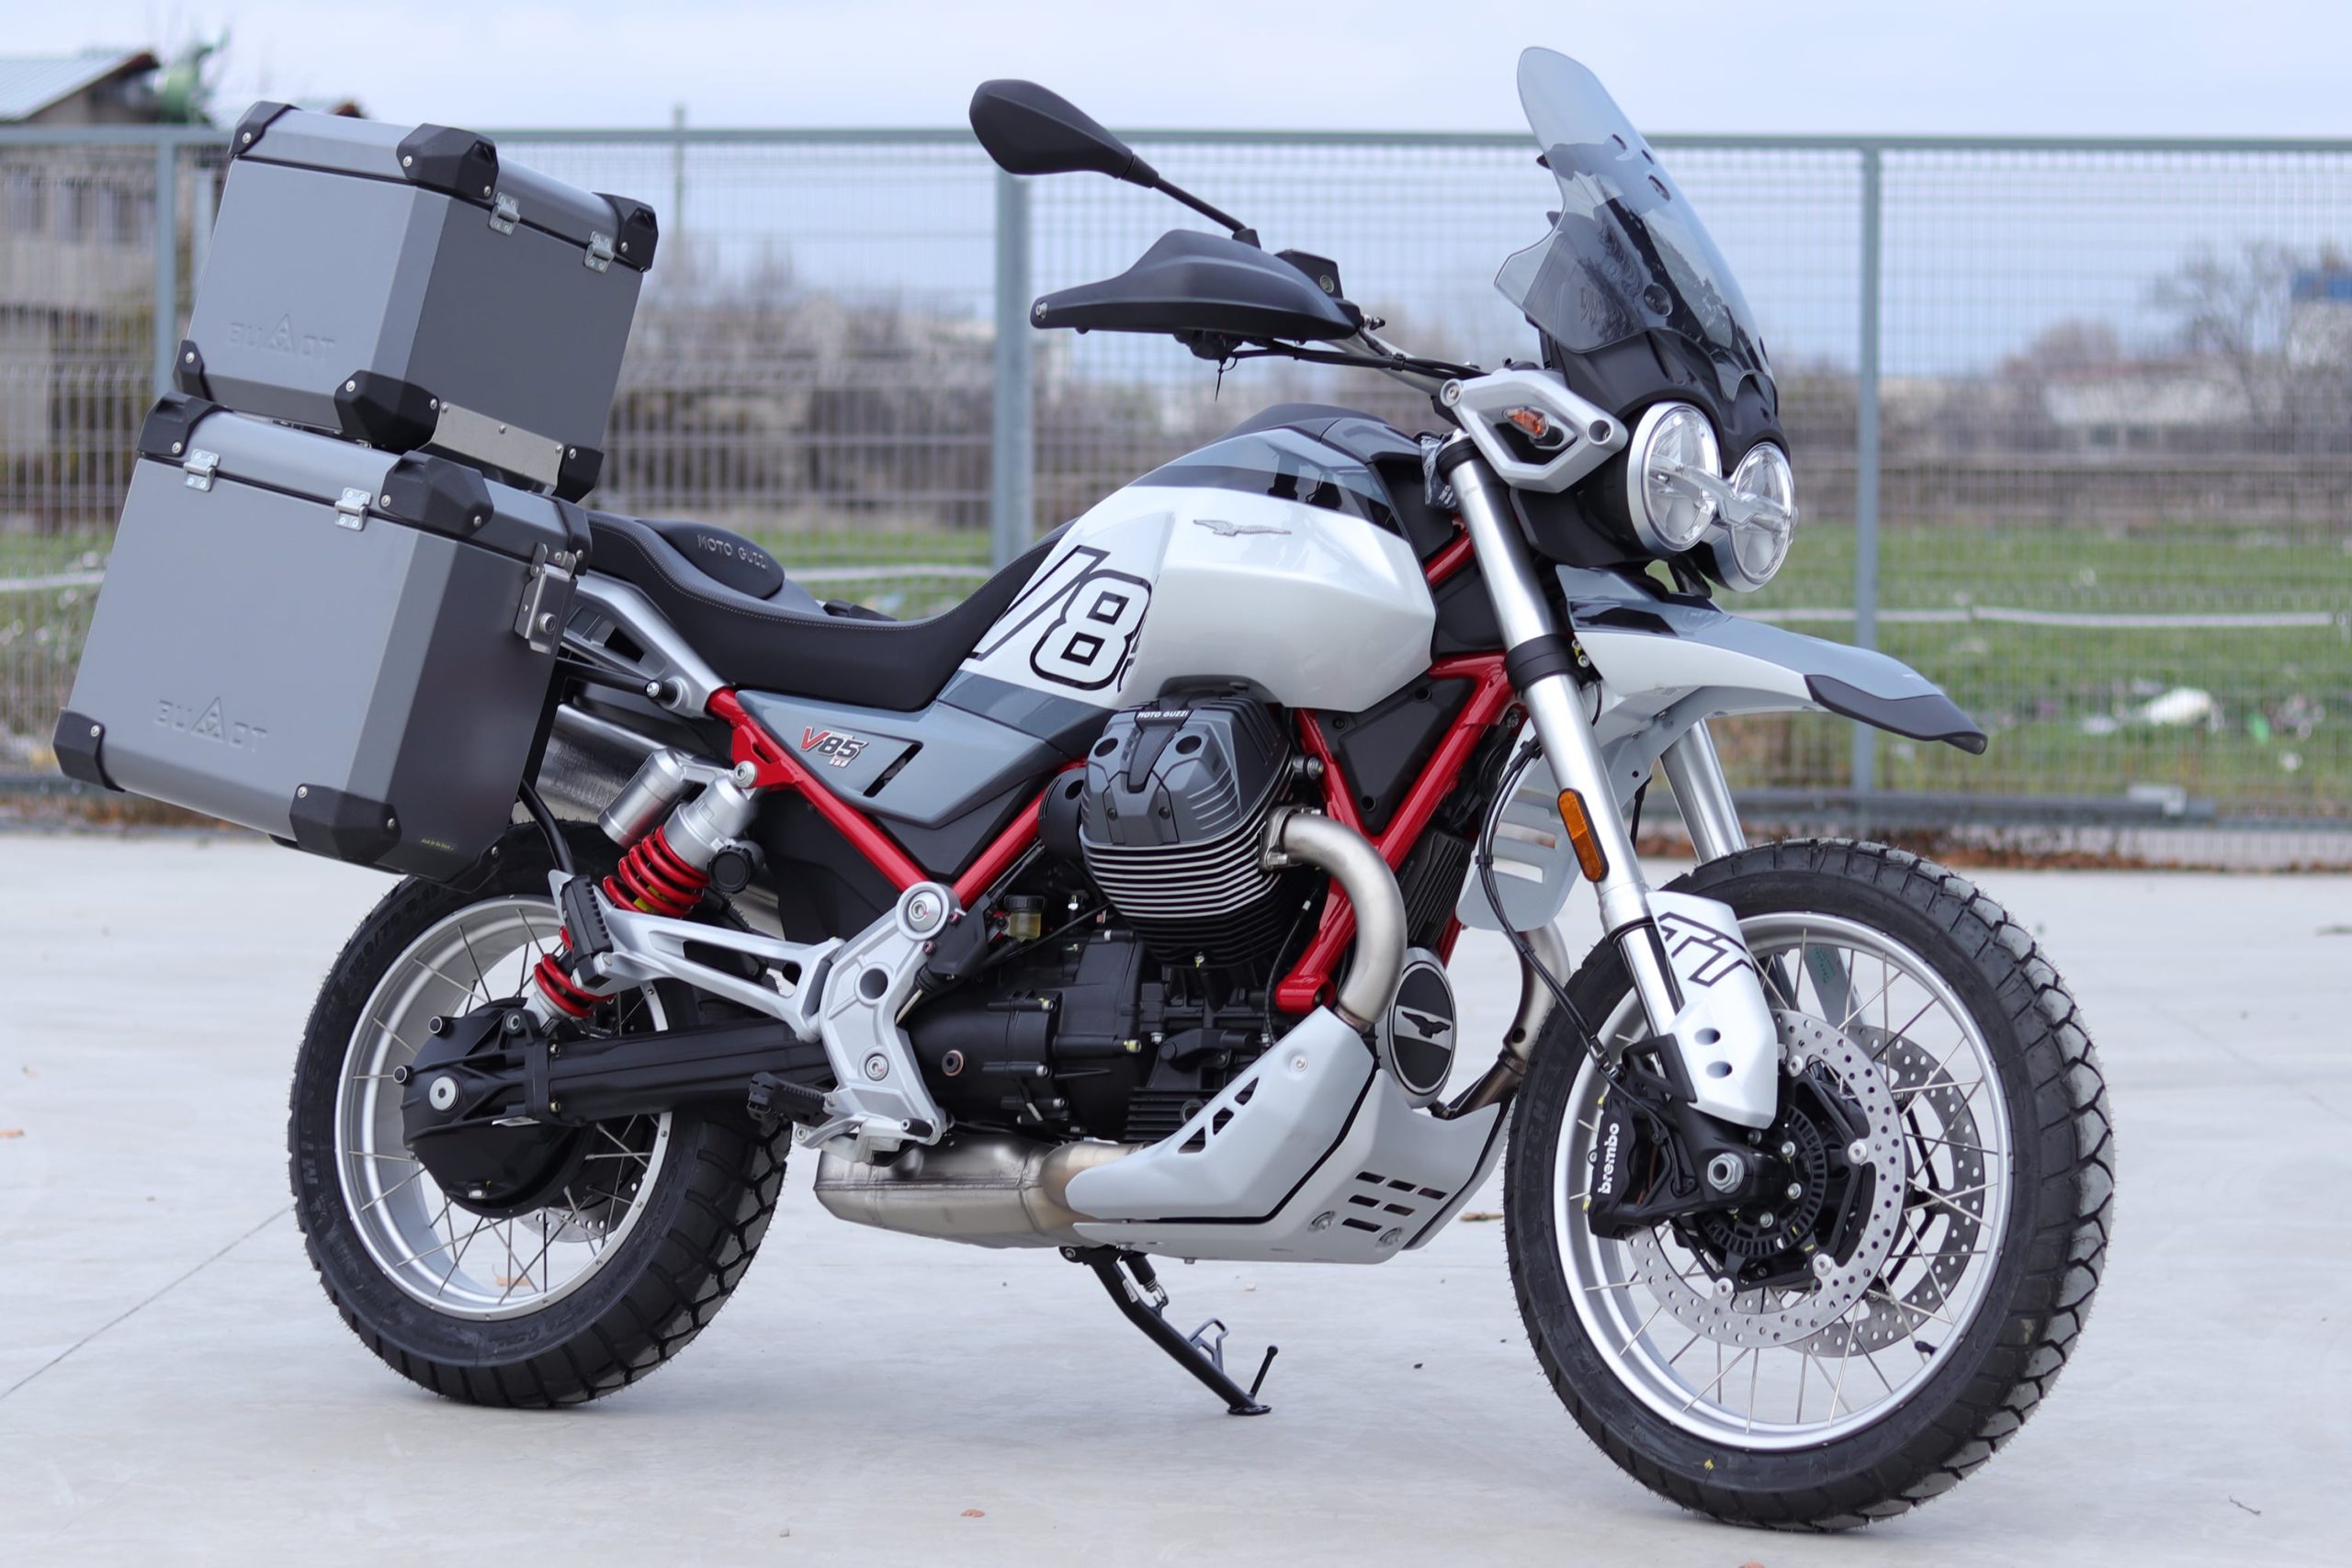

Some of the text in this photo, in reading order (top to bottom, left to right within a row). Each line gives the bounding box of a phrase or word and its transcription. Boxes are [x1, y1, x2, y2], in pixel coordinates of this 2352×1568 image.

[696, 534, 734, 557] MOTO
[1162, 709, 1190, 717] GUZZI
[800, 726, 866, 759] V85
[1598, 1122, 1620, 1194] brembo
